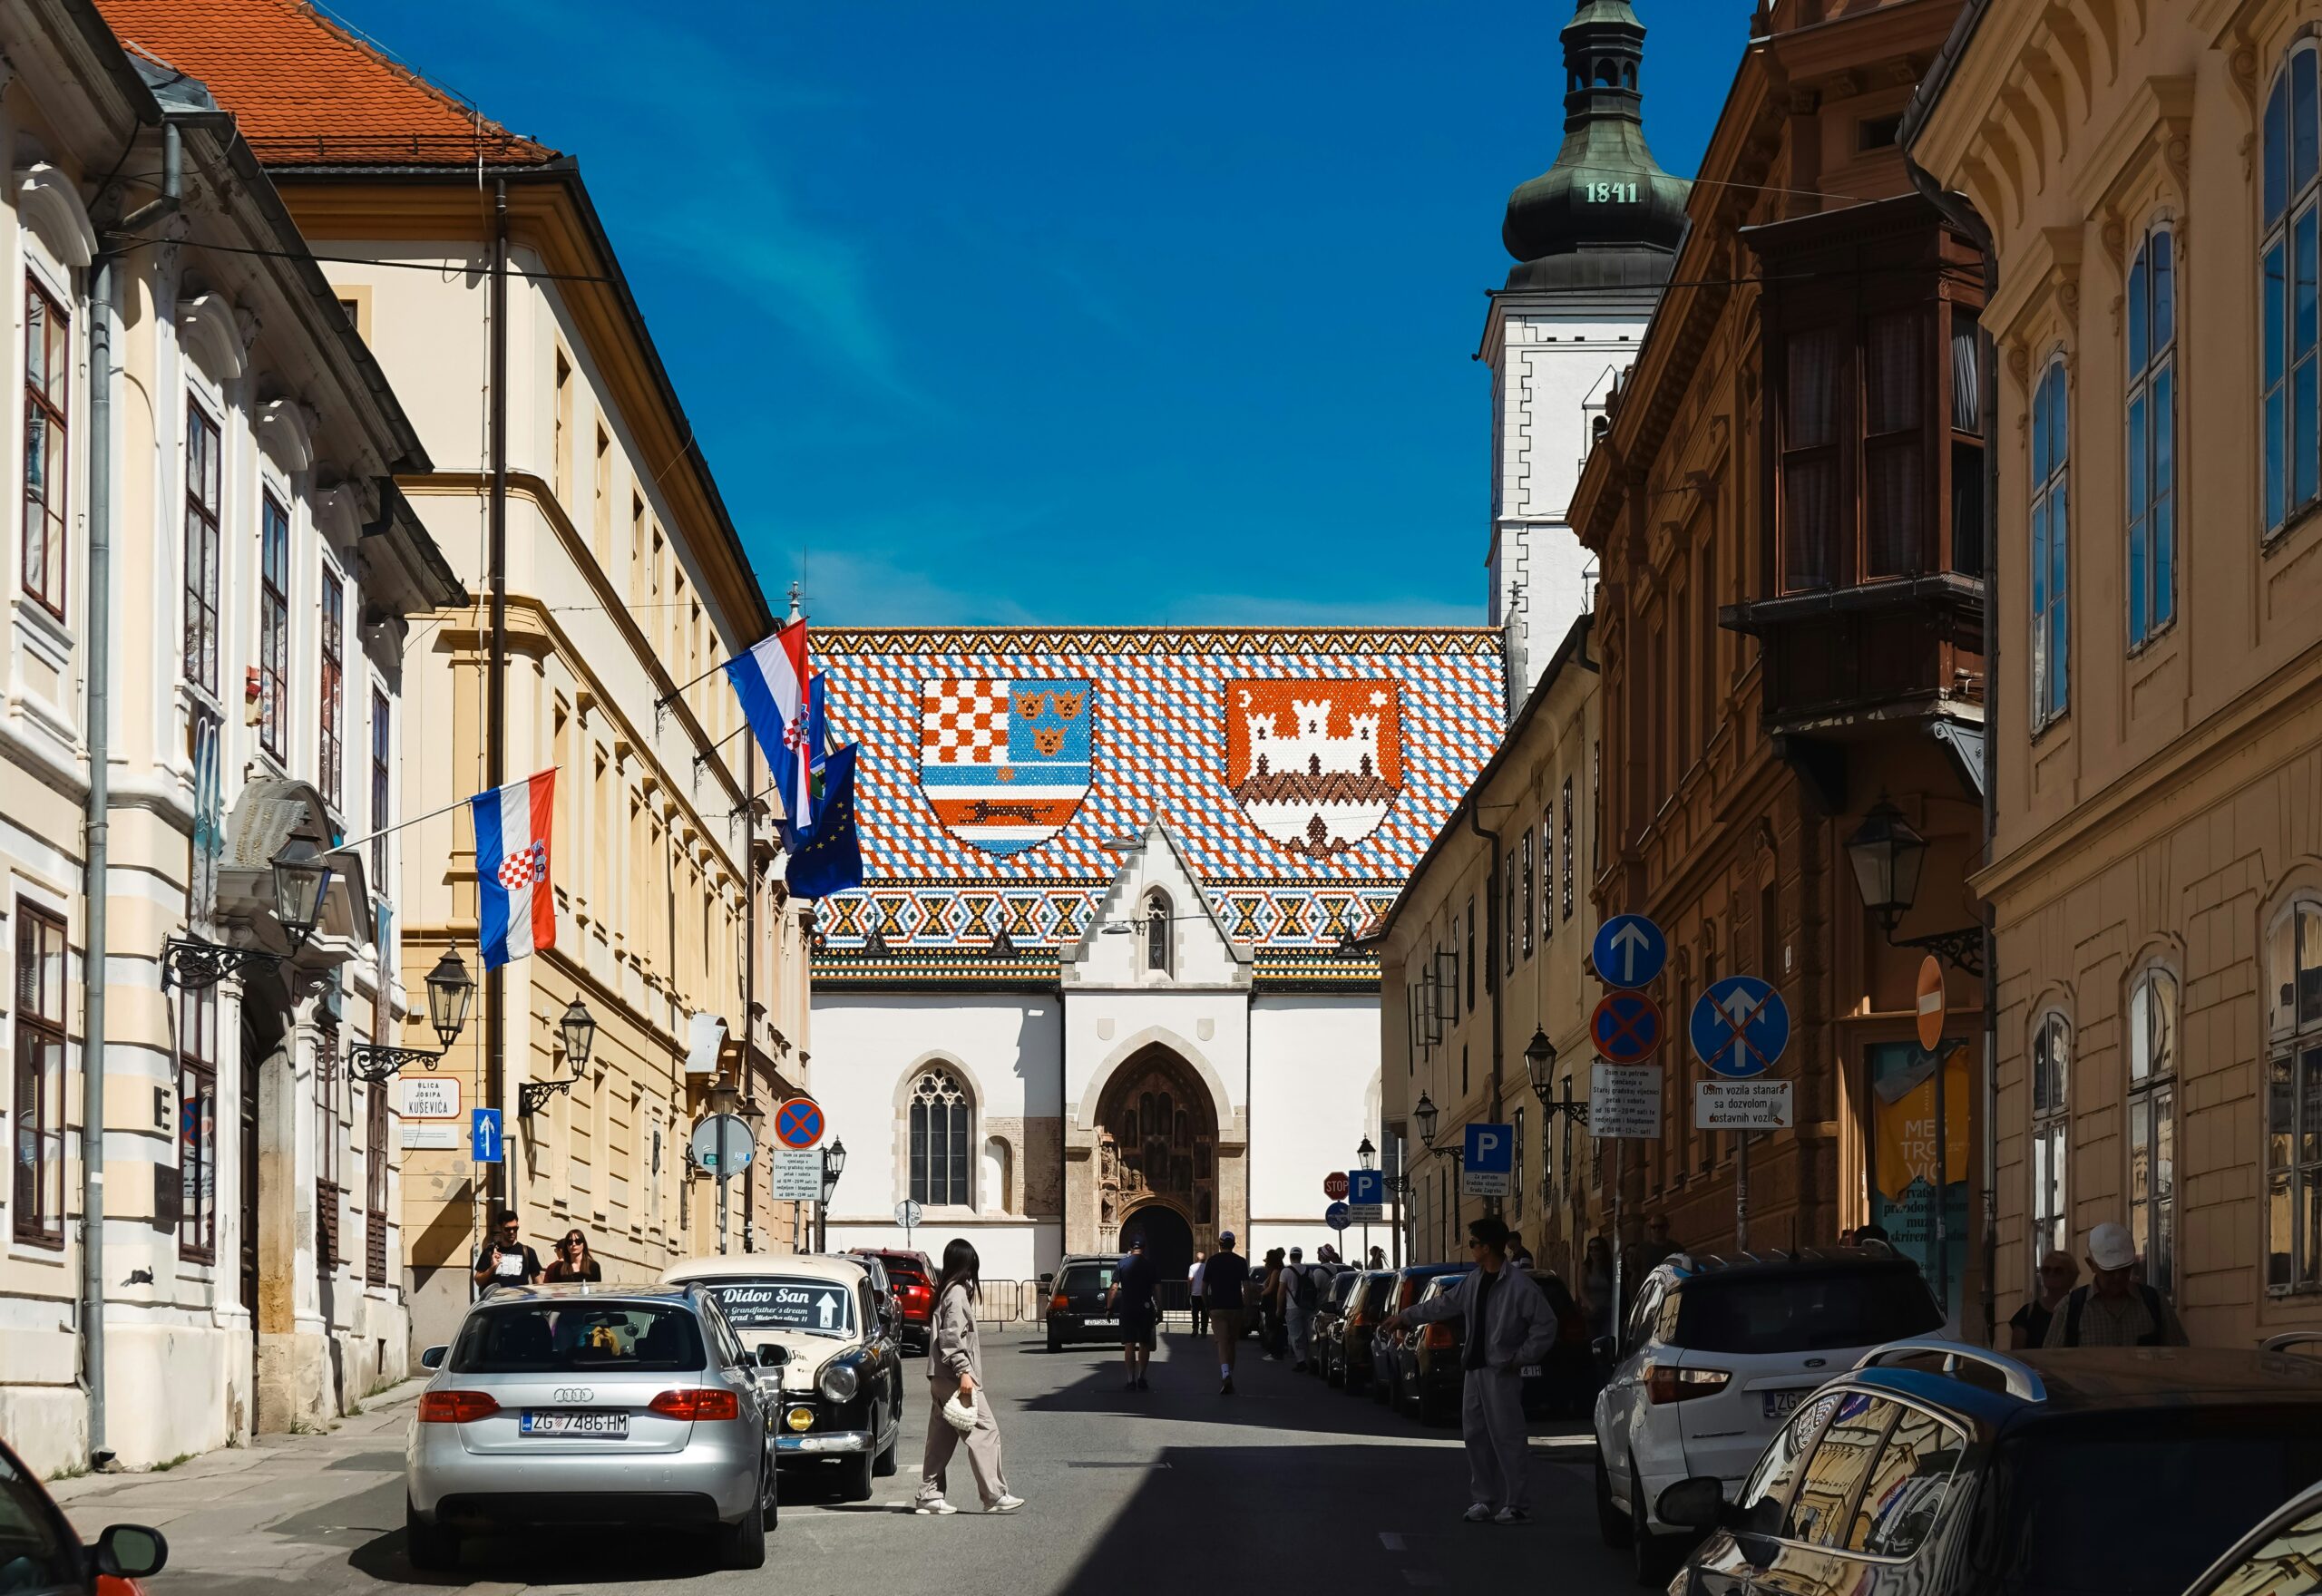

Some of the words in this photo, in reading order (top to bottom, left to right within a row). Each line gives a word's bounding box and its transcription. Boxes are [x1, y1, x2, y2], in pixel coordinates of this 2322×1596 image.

[1585, 181, 1636, 202] 1841
[1702, 1085, 1723, 1095] Osim
[1726, 1085, 1750, 1095] vozila
[1753, 1085, 1784, 1095] stanara
[409, 1099, 448, 1114] KUŠEVIĆA
[1713, 1100, 1724, 1108] sa
[1728, 1098, 1767, 1108] dozvolom
[1710, 1113, 1749, 1123] dostavnih
[1752, 1113, 1778, 1124] vozila
[1478, 1133, 1498, 1162] P
[1326, 1180, 1349, 1192] STOP
[1358, 1176, 1373, 1197] P
[723, 1289, 772, 1303] Didov
[776, 1288, 809, 1303] San
[731, 1307, 783, 1316] Grandfather's
[784, 1307, 808, 1315] dream
[1777, 1393, 1797, 1410] ZG
[533, 1413, 552, 1429] ZG
